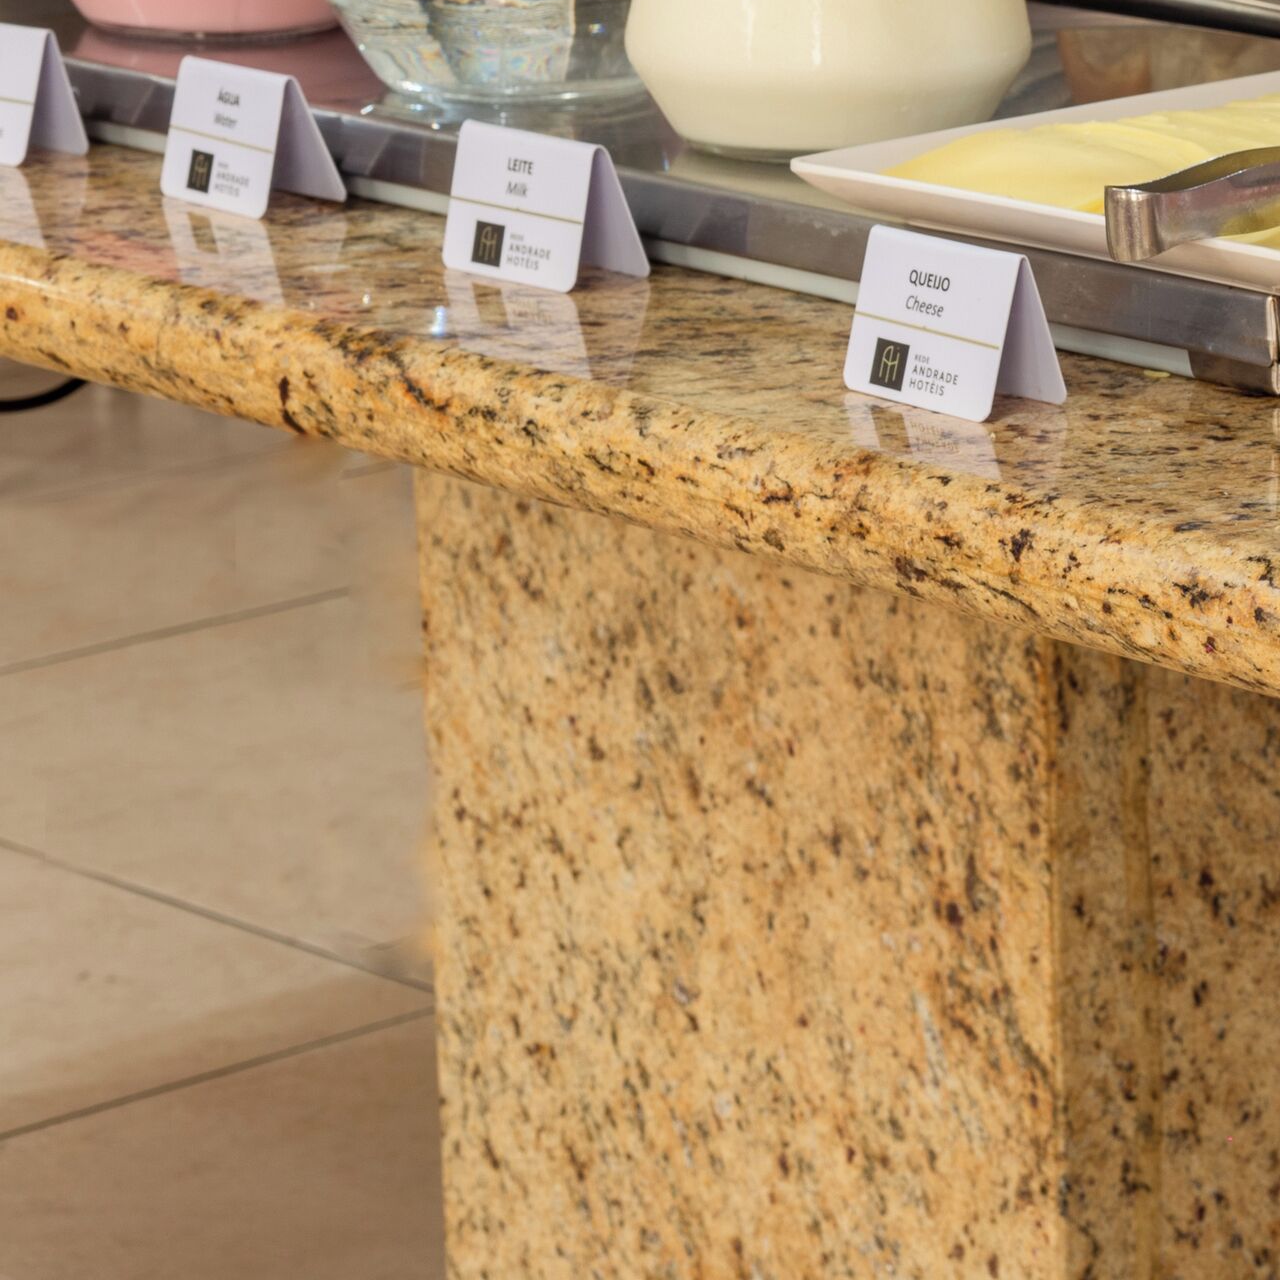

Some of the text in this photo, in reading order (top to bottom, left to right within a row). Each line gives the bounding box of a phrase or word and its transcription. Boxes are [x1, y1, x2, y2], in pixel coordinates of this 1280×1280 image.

[216, 87, 241, 107] ÁGUA
[507, 157, 534, 176] LEITE
[505, 181, 528, 198] Milk
[508, 243, 552, 261] ANDRADE
[506, 255, 540, 271] HOTÉIS
[908, 269, 951, 293] QUEIJO
[905, 295, 945, 318] Cheese
[911, 365, 959, 386] ANDRADE
[908, 377, 945, 397] HOTÉIS
